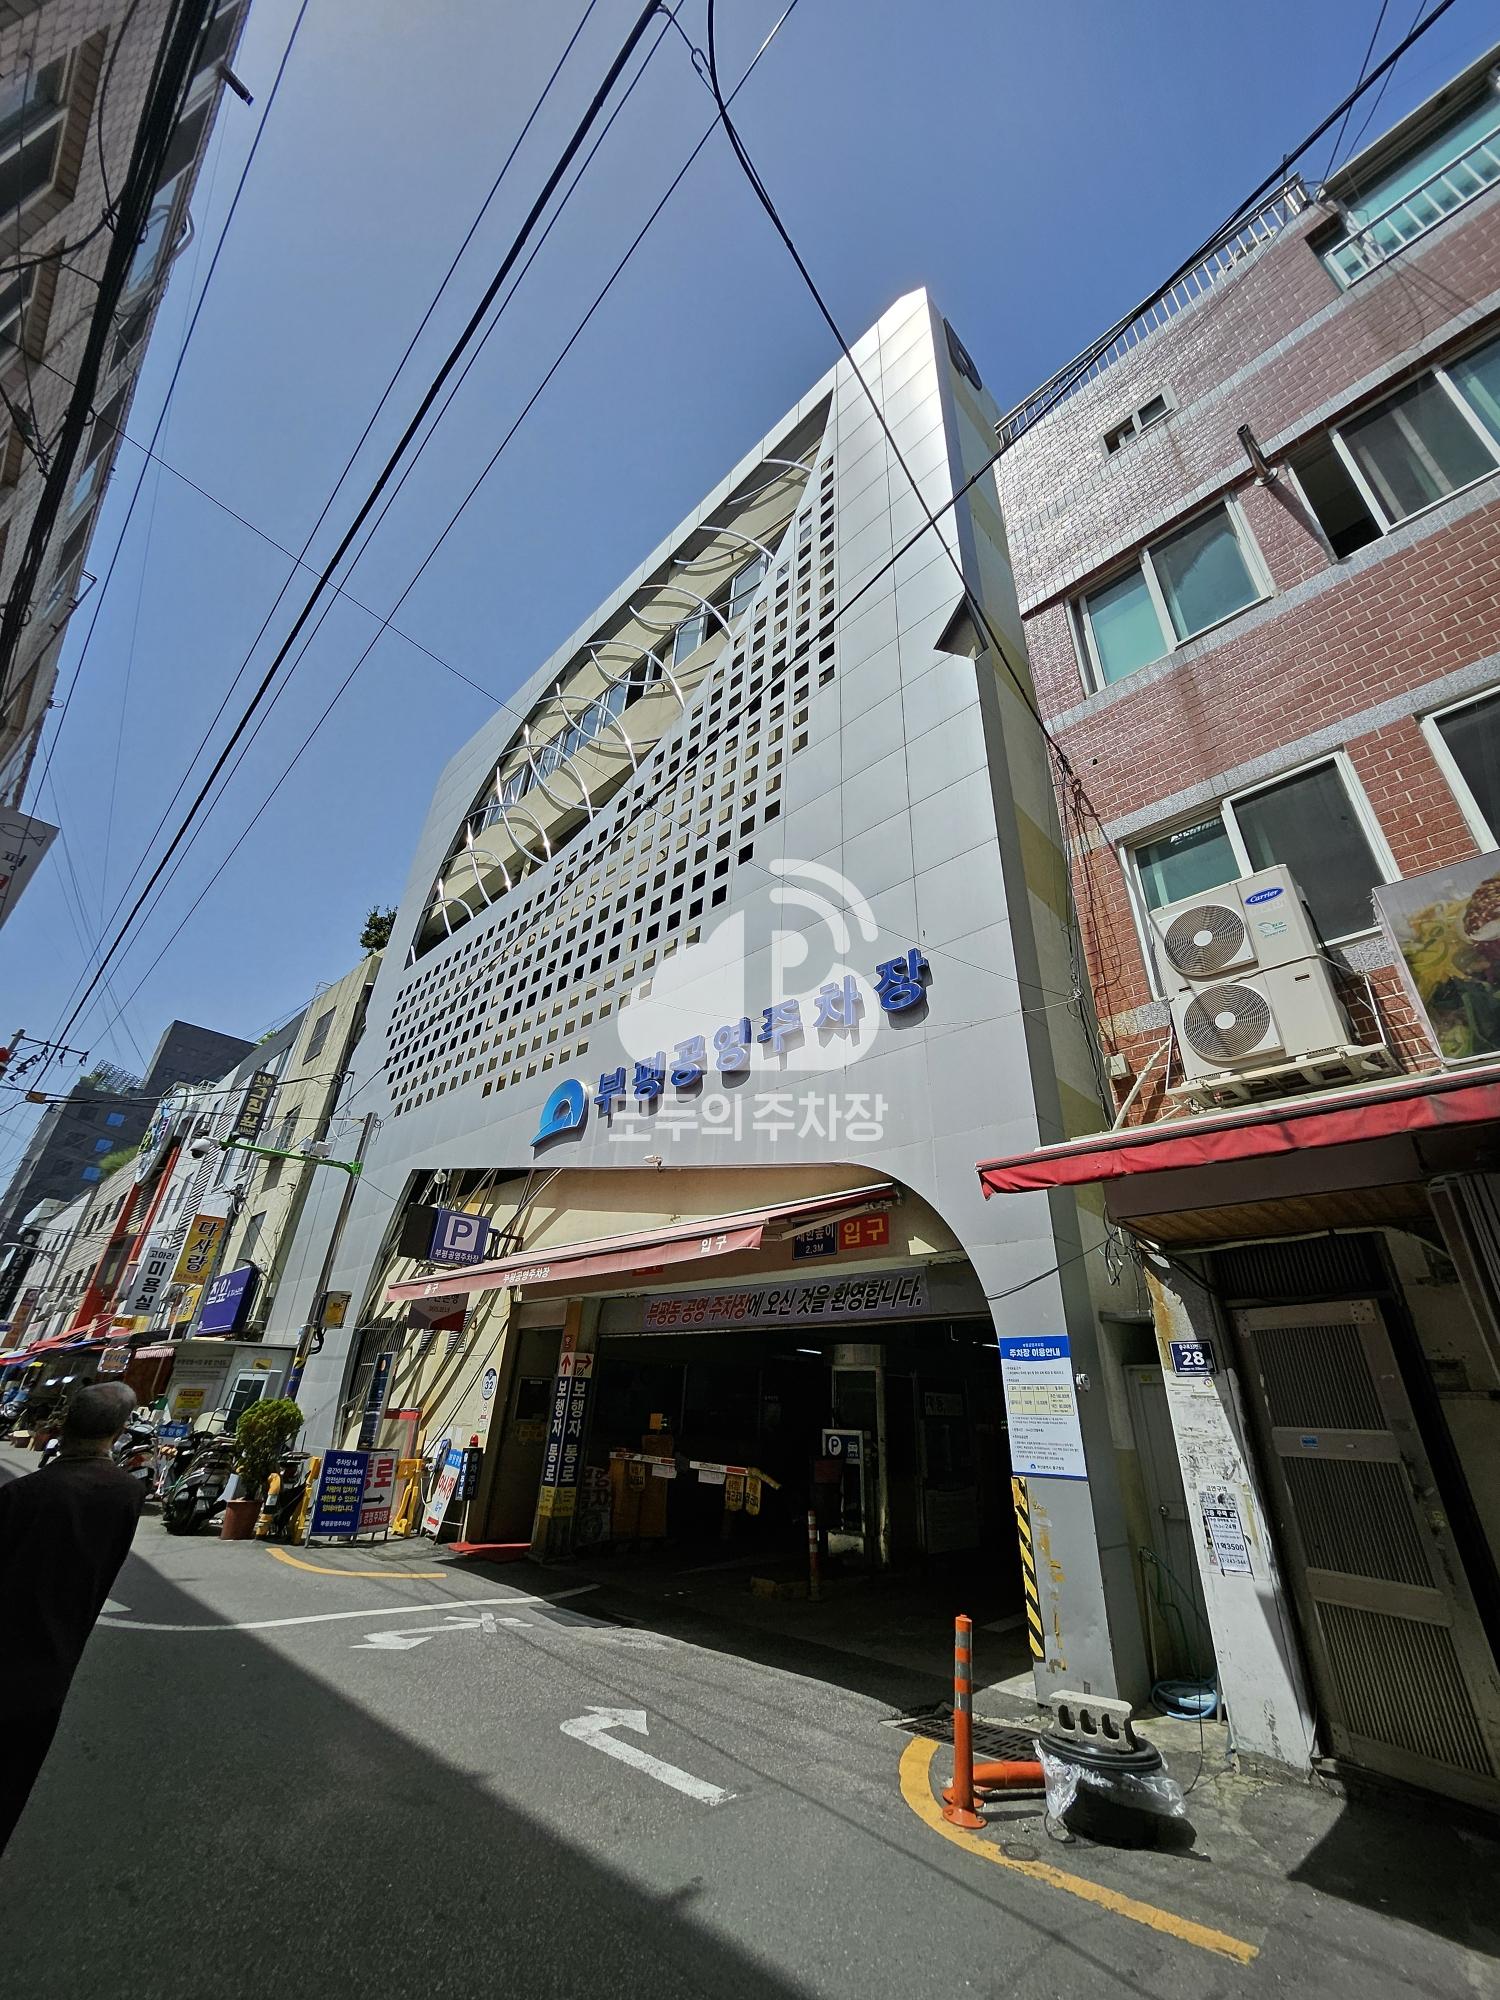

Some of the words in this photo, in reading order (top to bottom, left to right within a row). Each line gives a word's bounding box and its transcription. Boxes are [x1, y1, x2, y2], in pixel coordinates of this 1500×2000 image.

[1250, 889, 1279, 903] Carrier
[594, 947, 931, 1116] 부평공영주차장
[450, 1219, 473, 1246] P
[700, 1235, 727, 1253] 입구
[844, 1218, 885, 1244] 입구
[149, 1250, 175, 1260] 고아라
[186, 1221, 218, 1273] 다사랑
[434, 1248, 479, 1263] 부평공영주차장
[805, 1243, 824, 1254] 2.3M
[134, 1260, 166, 1311] 미용실
[646, 1301, 682, 1326] 부평동
[681, 1298, 708, 1324] 공영
[711, 1292, 763, 1321] 주차장에
[762, 1289, 798, 1316] 오신
[796, 1285, 831, 1316] 것을
[830, 1275, 922, 1312] 환영합니다.
[1009, 1348, 1030, 1358] 주차장
[1032, 1347, 1061, 1357] 이용안내
[1181, 1351, 1205, 1366] 28
[484, 1381, 494, 1390] 32
[551, 1380, 568, 1437] 보행자
[567, 1381, 586, 1438] 보행자
[335, 1459, 351, 1467] 주차장
[352, 1459, 358, 1467] 내
[544, 1443, 558, 1482] 통로
[560, 1444, 578, 1482] 통로
